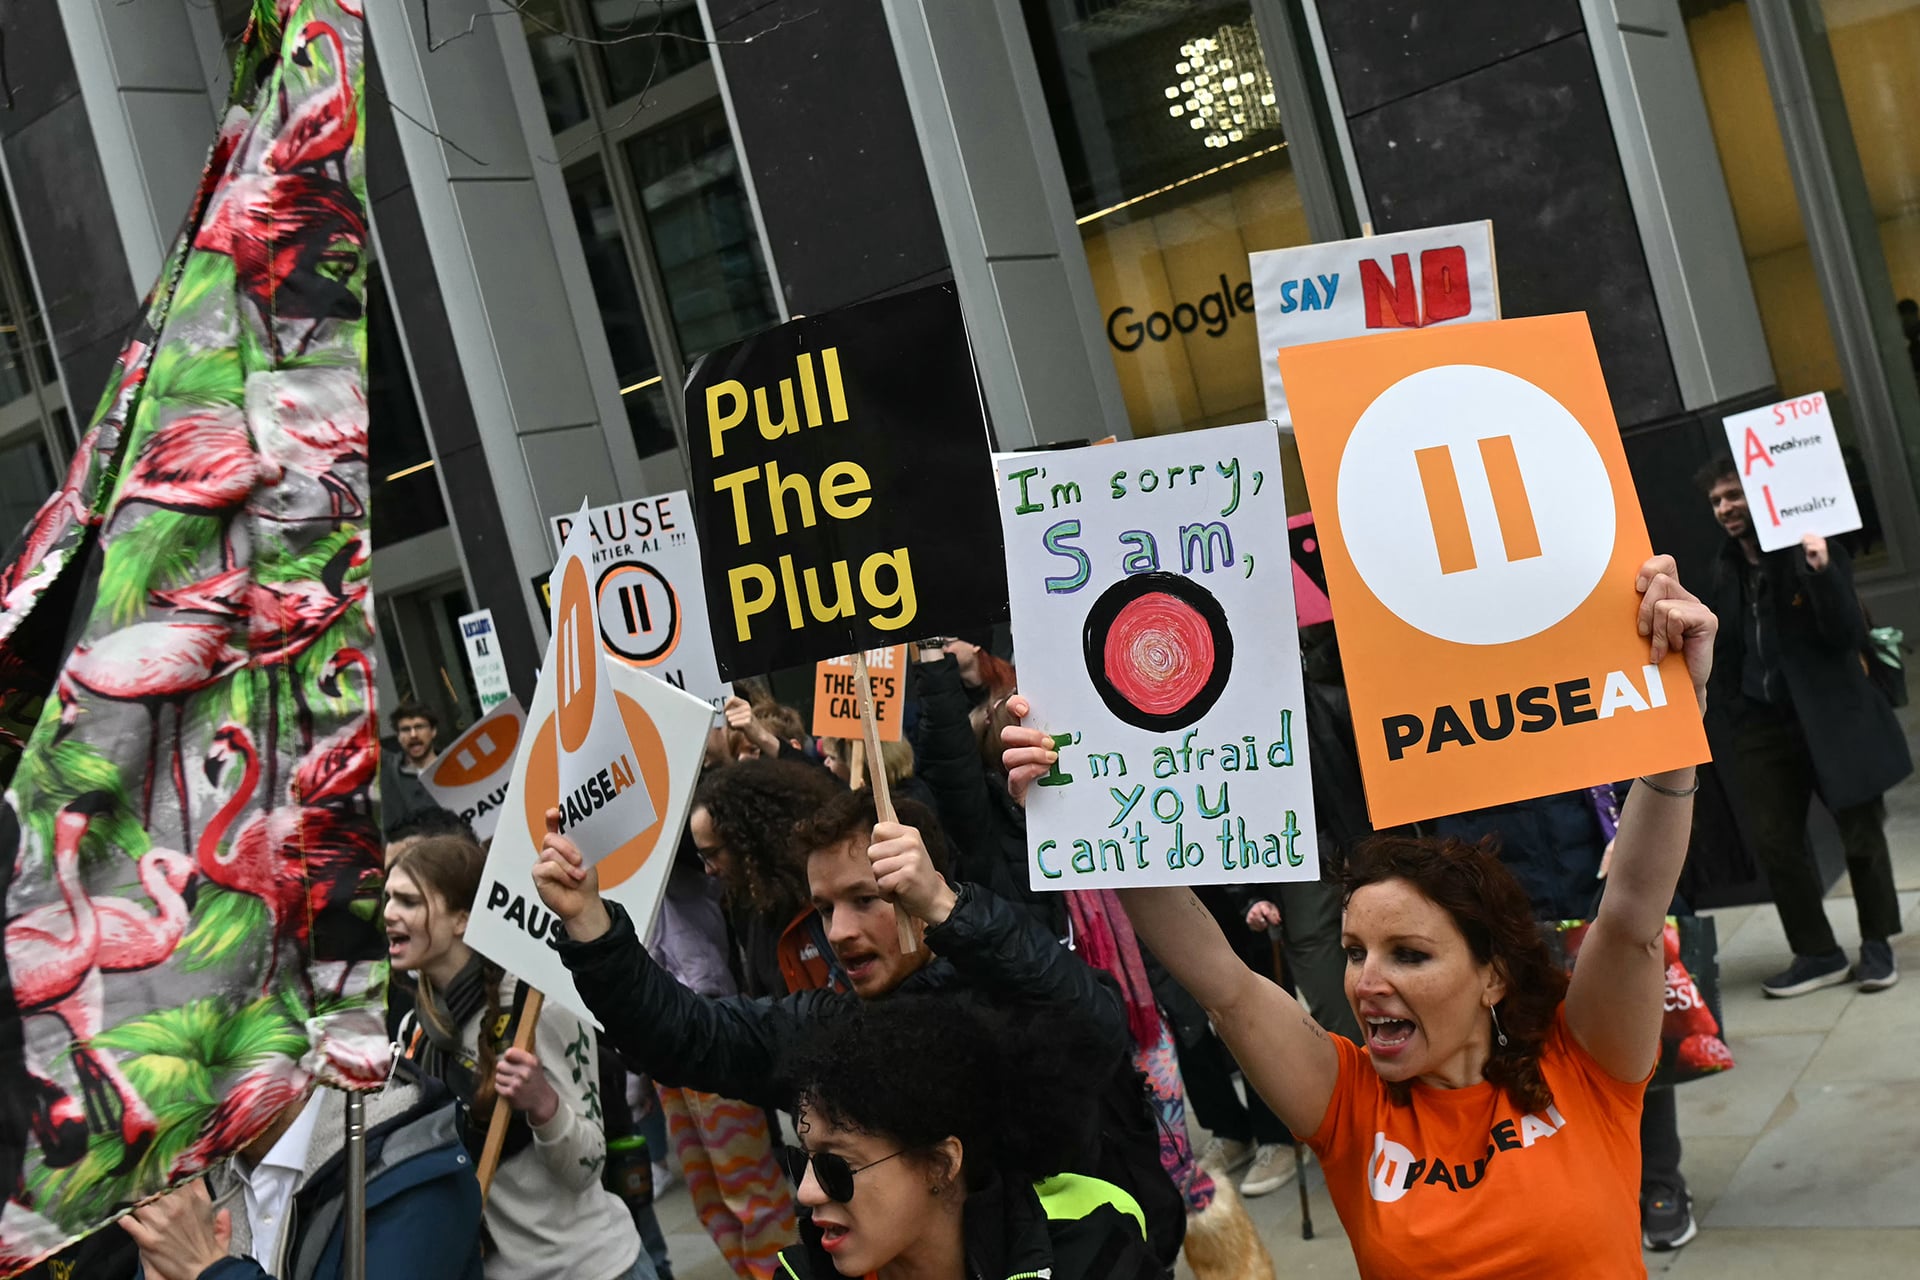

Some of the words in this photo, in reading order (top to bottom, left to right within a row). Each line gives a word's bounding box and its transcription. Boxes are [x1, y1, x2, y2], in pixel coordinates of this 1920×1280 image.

[1106, 274, 1255, 352] Google
[1280, 273, 1339, 313] SAY
[1359, 245, 1472, 328] NO
[706, 347, 849, 458] Pull
[1772, 396, 1824, 426] STOP
[713, 460, 872, 545] The
[1008, 467, 1082, 515] I'm
[1110, 458, 1263, 517] sorry,
[592, 543, 634, 564] NTIER
[1043, 519, 1254, 594] Sam,
[728, 547, 917, 642] Plug
[824, 673, 895, 698] THEE'S
[830, 698, 886, 721] CAUE
[1381, 664, 1668, 761] PAUSEAI
[1037, 731, 1127, 787] I'm
[1153, 709, 1294, 778] afraid
[460, 781, 510, 825] PAU
[558, 753, 636, 836] PAUSEAI
[1037, 821, 1149, 878] can't
[1166, 822, 1204, 870] do
[1216, 810, 1304, 870] that
[487, 880, 563, 952] PAUS
[1664, 980, 1704, 1012] est
[1403, 1103, 1567, 1193] PAUEAI
